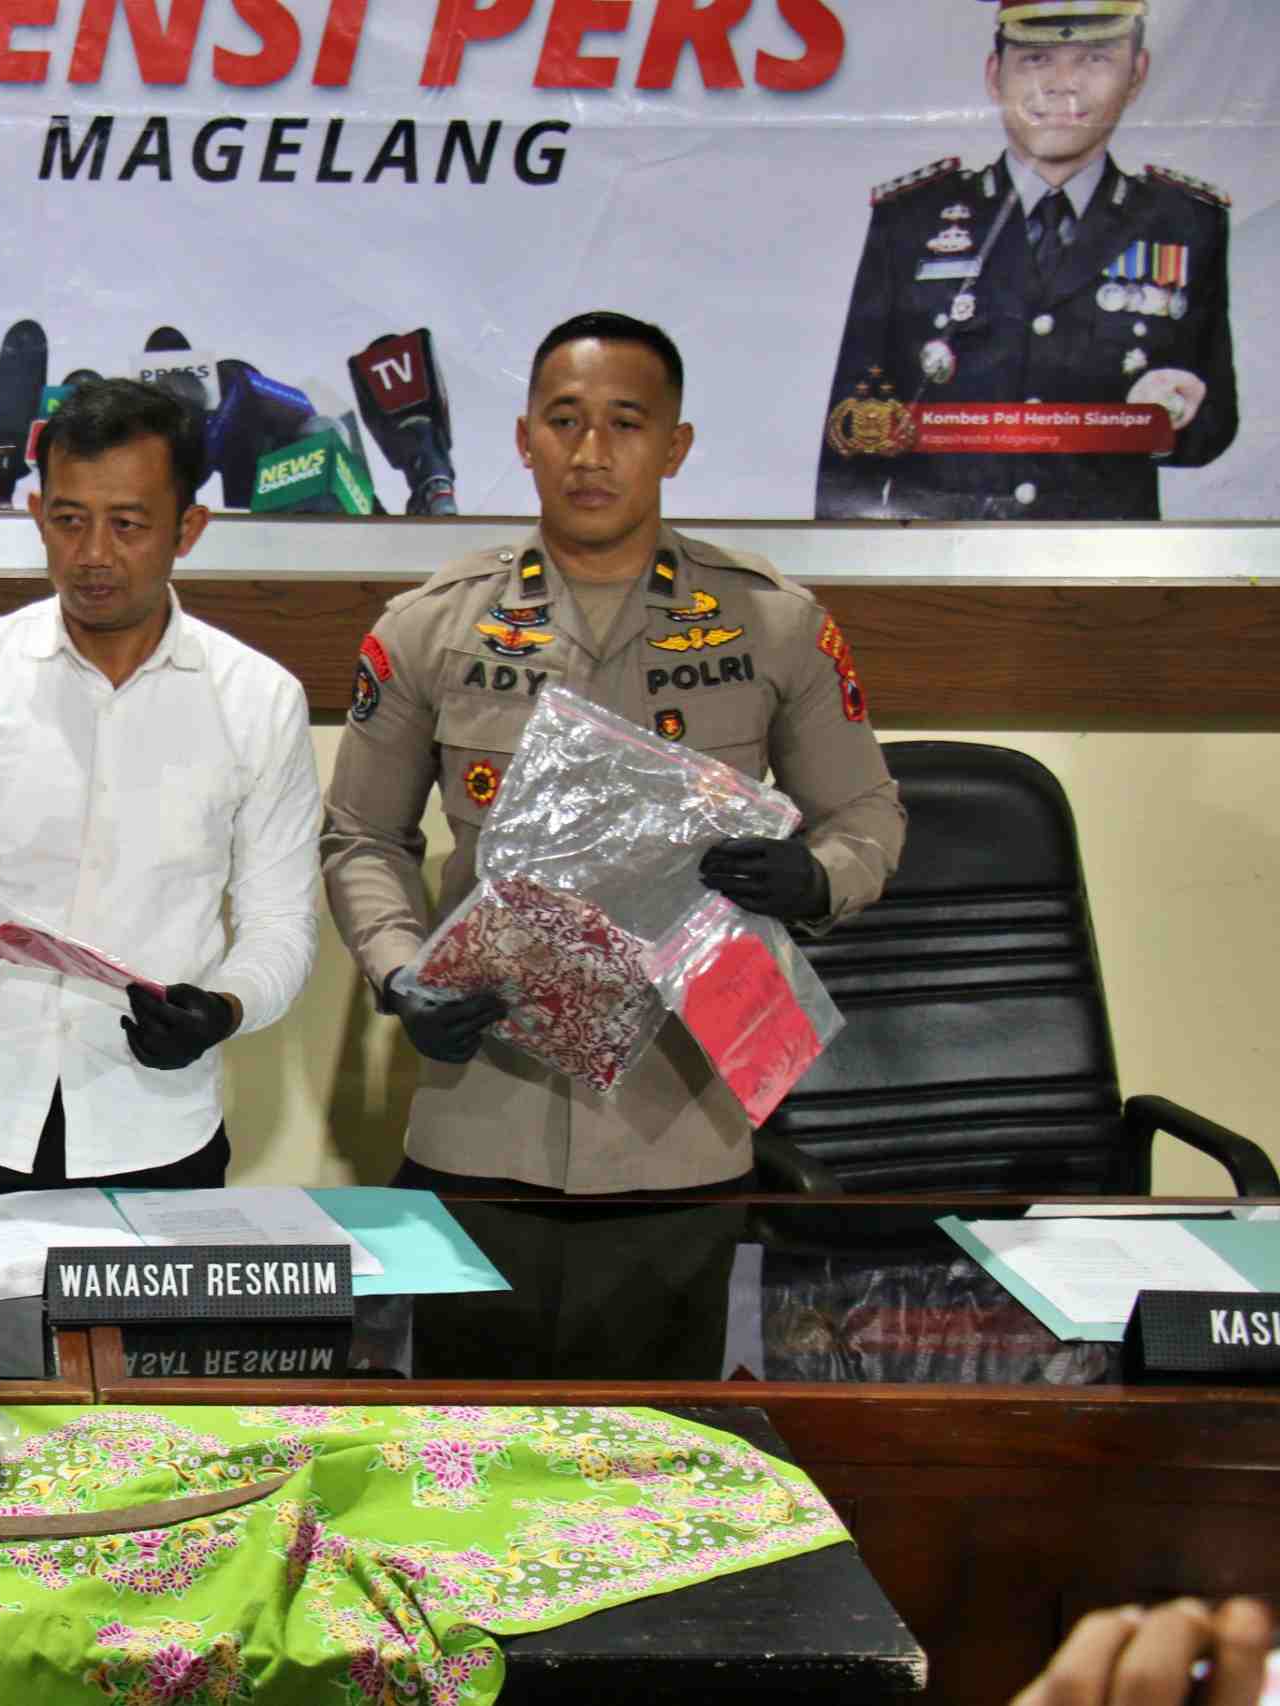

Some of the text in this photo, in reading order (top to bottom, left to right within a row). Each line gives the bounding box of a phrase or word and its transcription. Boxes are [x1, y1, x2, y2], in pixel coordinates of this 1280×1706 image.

[418, 0, 845, 92] PERS
[38, 116, 571, 184] MAGELANG
[371, 352, 413, 391] TV
[922, 412, 1151, 429] Kombes Pol Herbin Sianipar
[260, 449, 326, 484] NEWS
[463, 661, 547, 696] ADY
[647, 653, 754, 694] POLRI
[59, 1262, 337, 1297] WAKASAT RESKRIM
